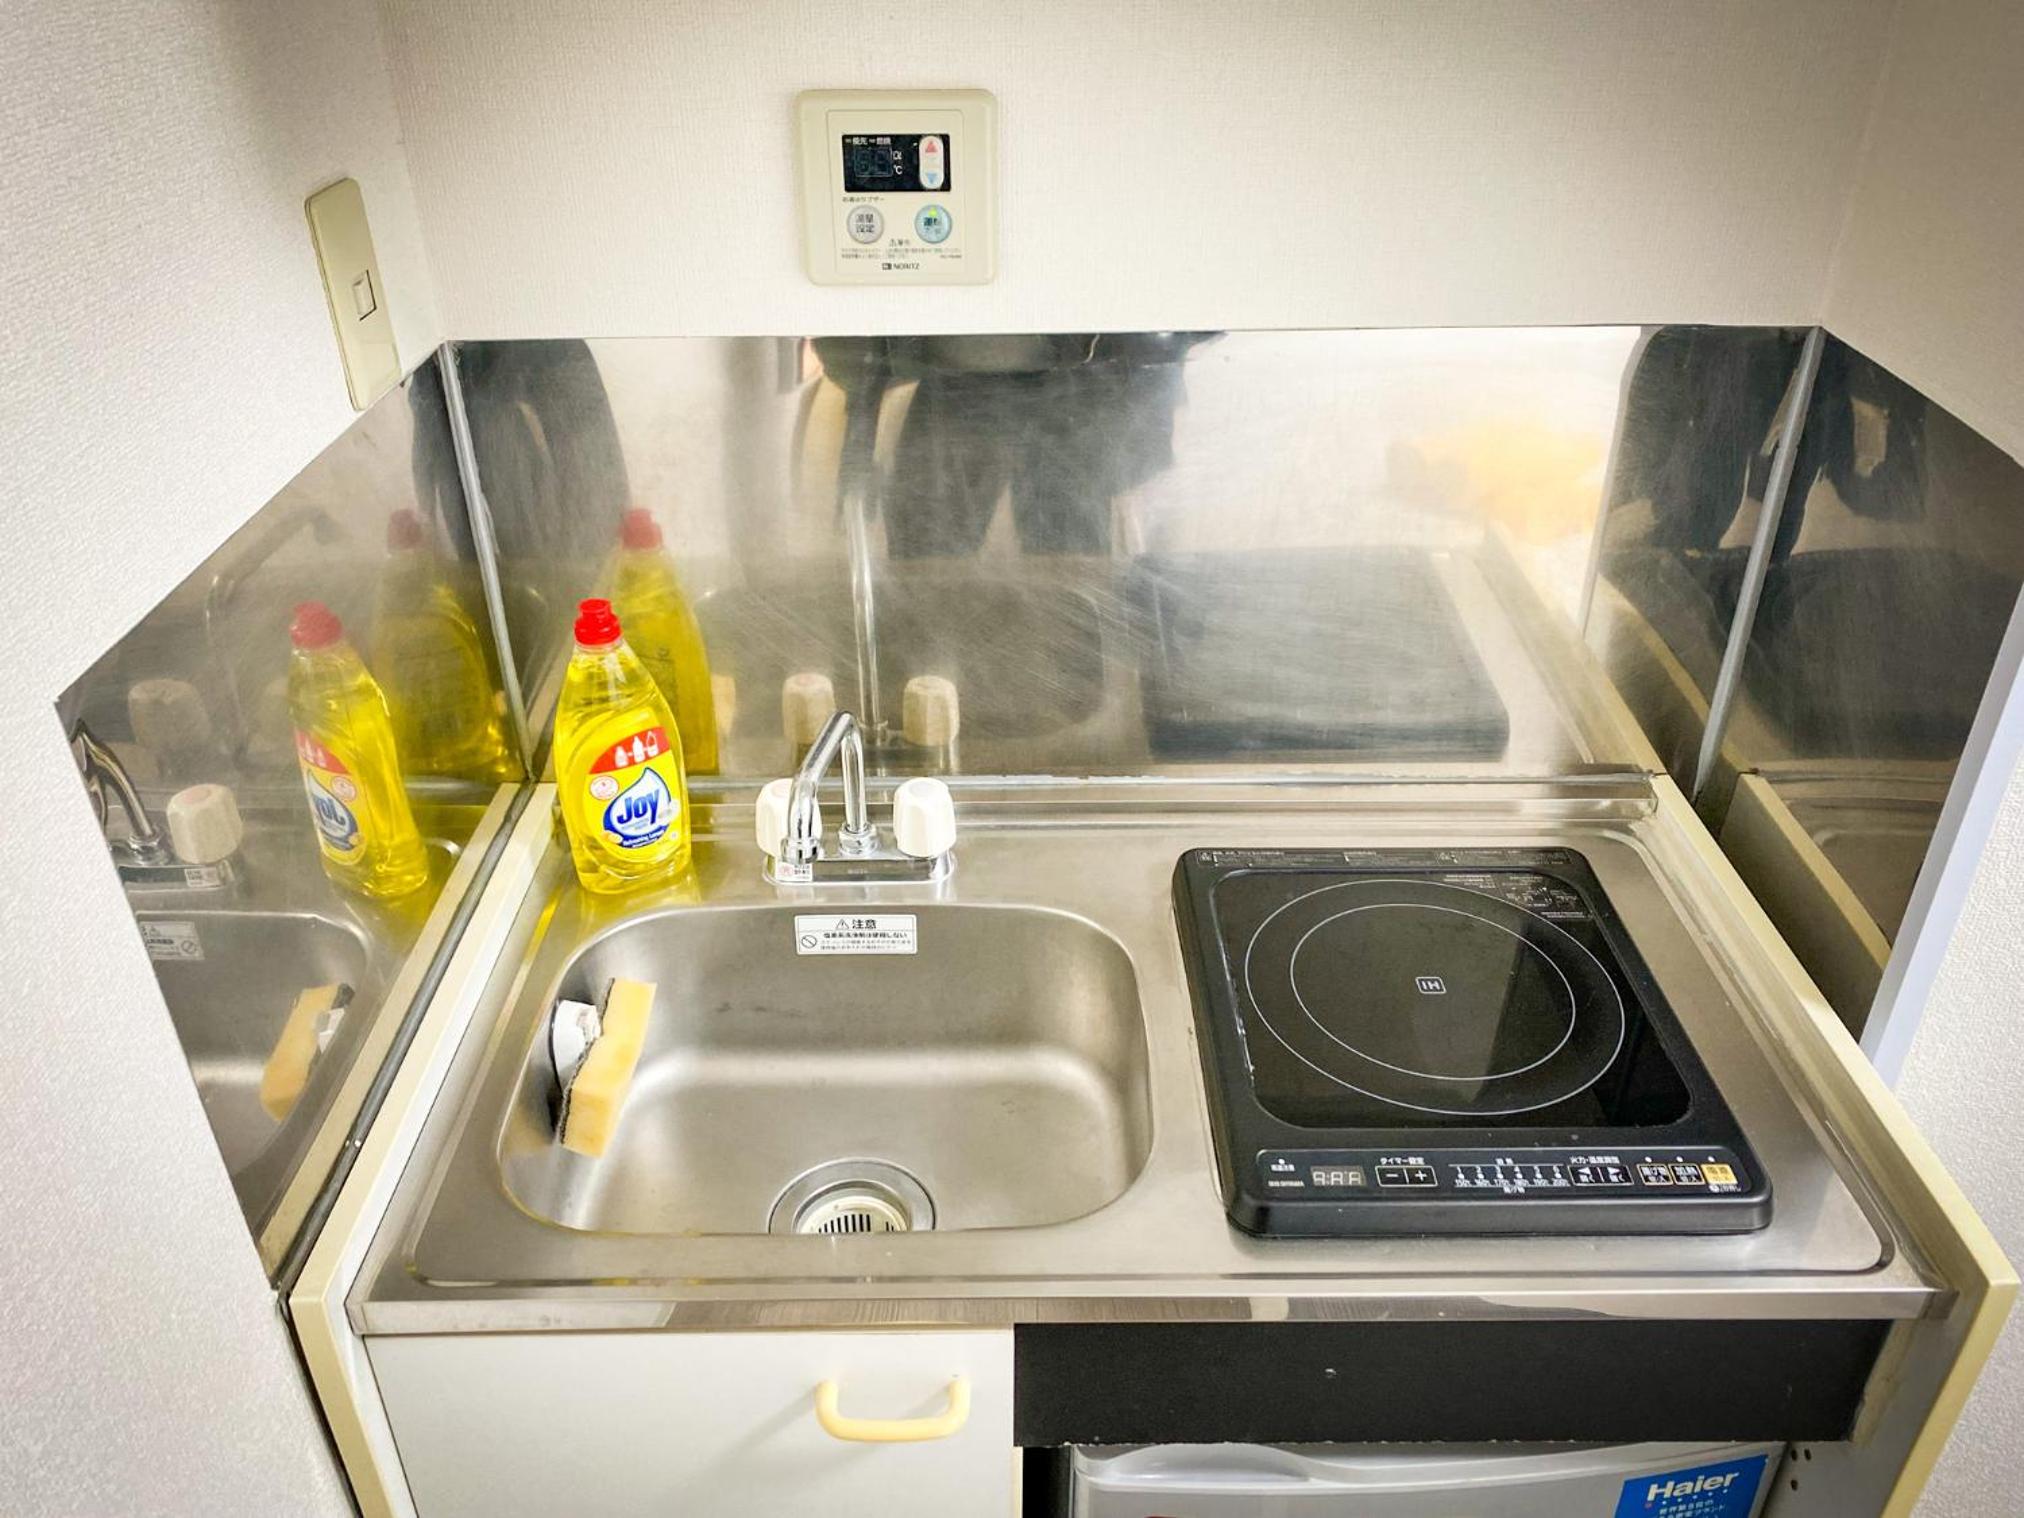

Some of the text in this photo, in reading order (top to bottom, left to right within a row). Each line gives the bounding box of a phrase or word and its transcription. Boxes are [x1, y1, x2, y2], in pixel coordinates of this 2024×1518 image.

[852, 919, 876, 930] 注意
[1421, 980, 1441, 990] IH
[1647, 1472, 1740, 1501] Haier
